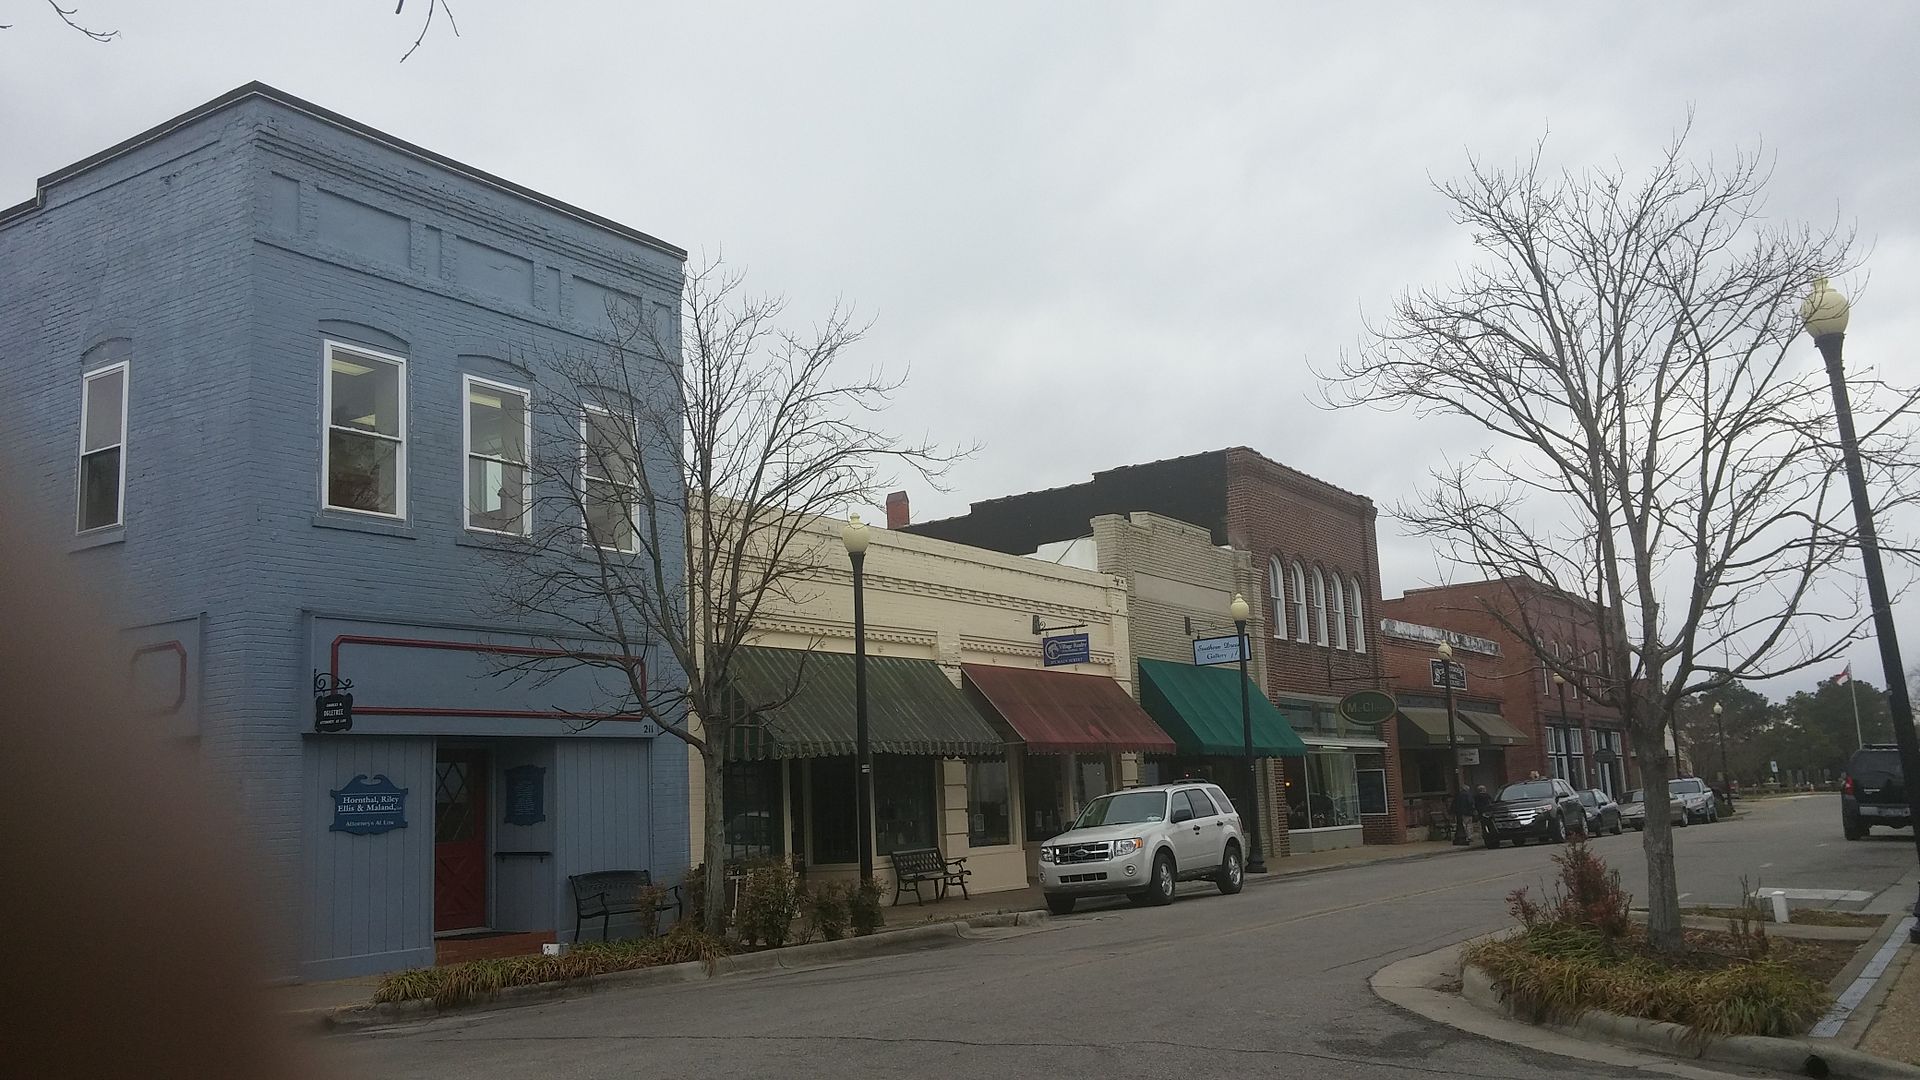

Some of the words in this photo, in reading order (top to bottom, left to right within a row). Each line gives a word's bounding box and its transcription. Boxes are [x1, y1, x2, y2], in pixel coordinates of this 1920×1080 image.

[643, 724, 654, 734] 211
[342, 796, 379, 804] Hornthal,
[381, 795, 399, 804] Riley
[338, 804, 354, 812] Ellis
[357, 804, 364, 812] &
